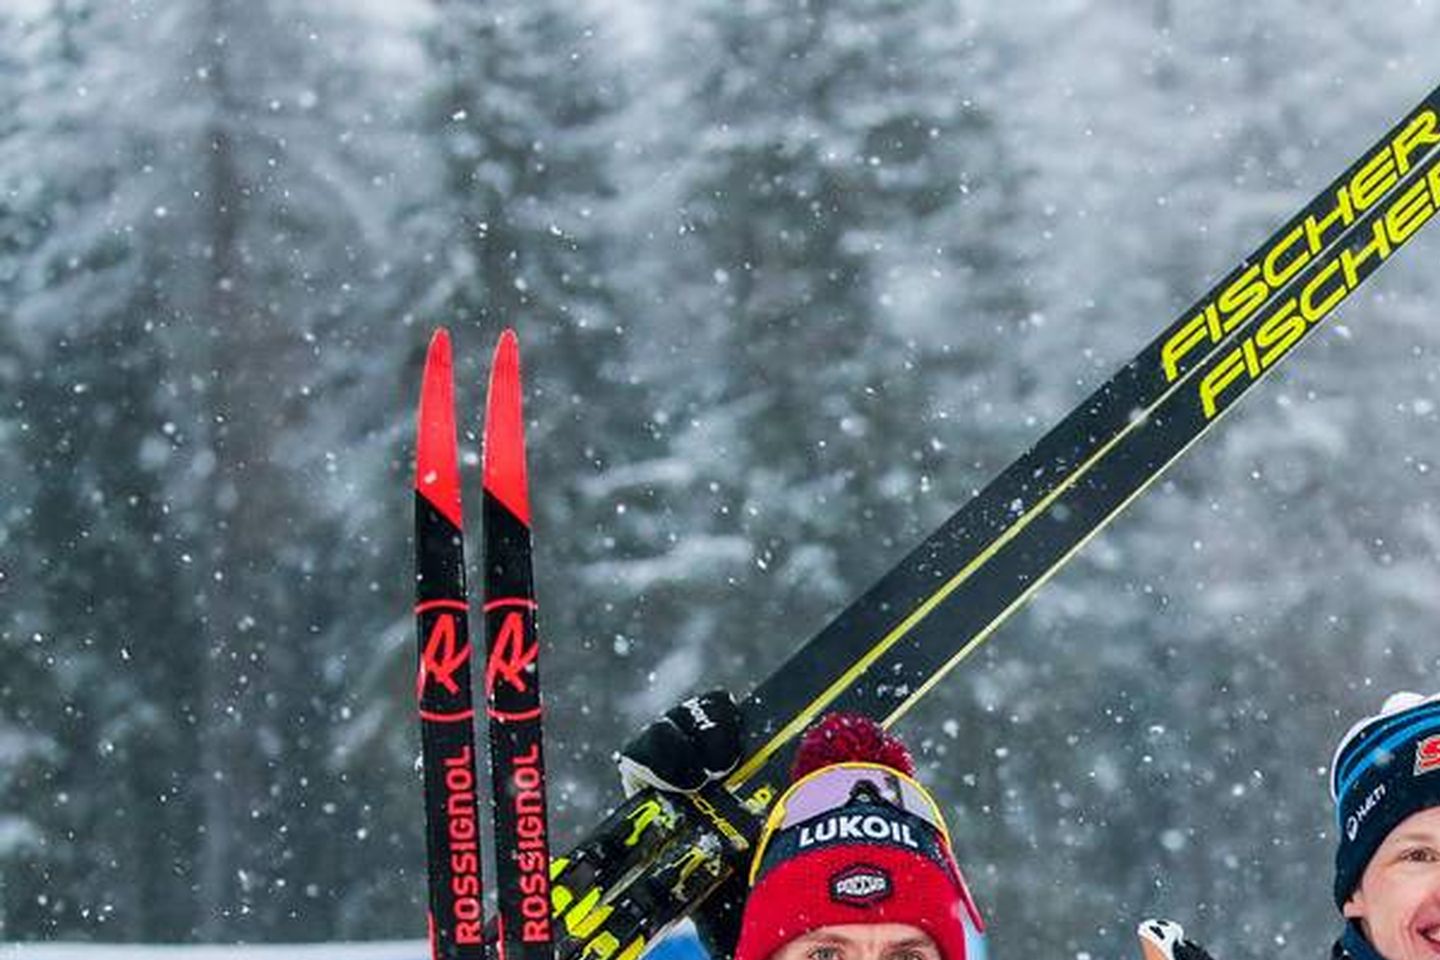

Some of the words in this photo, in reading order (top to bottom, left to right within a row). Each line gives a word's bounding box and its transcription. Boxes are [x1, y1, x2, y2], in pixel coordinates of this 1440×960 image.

[446, 746, 483, 944] ROSSIGNOL
[513, 745, 550, 943] ROSSIGNOL
[800, 815, 918, 848] LUKOIL
